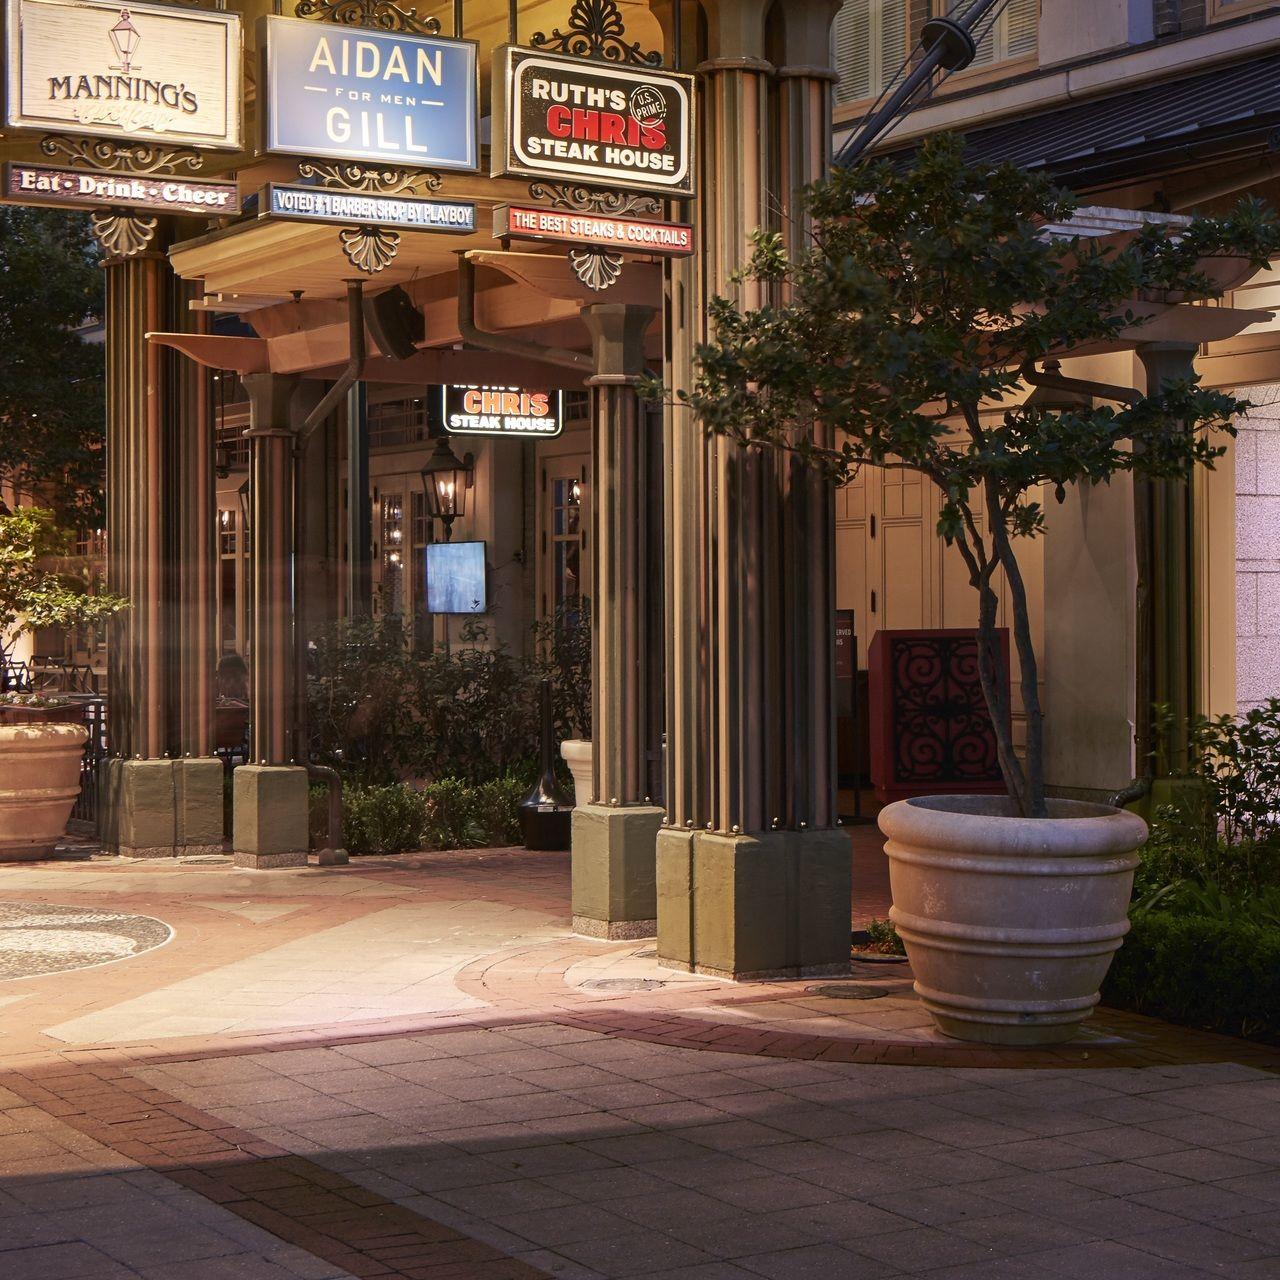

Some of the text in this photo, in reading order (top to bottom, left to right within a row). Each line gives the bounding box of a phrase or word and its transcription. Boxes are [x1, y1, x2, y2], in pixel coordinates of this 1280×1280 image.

[308, 36, 442, 86] AIDAN
[47, 74, 198, 115] MANNING'S
[335, 87, 416, 106] FOR MEN
[531, 78, 627, 111] RUTH'S
[635, 102, 662, 120] PRIME
[637, 92, 654, 106] U.S.
[326, 106, 428, 153] GILL
[546, 104, 667, 150] CHRIS
[527, 136, 675, 171] STEAK HOUSE
[20, 170, 230, 206] Eat Drink Cheer
[277, 191, 314, 211] VOTED
[332, 196, 377, 217] BARBER
[377, 200, 405, 219] SHOP
[407, 203, 421, 221] BY
[423, 204, 472, 224] PLAYBOY
[513, 212, 688, 246] THE BEST STEAKS & COCKTAILS
[463, 390, 550, 417] CHRIS
[450, 414, 556, 431] STEAK HOUSE
